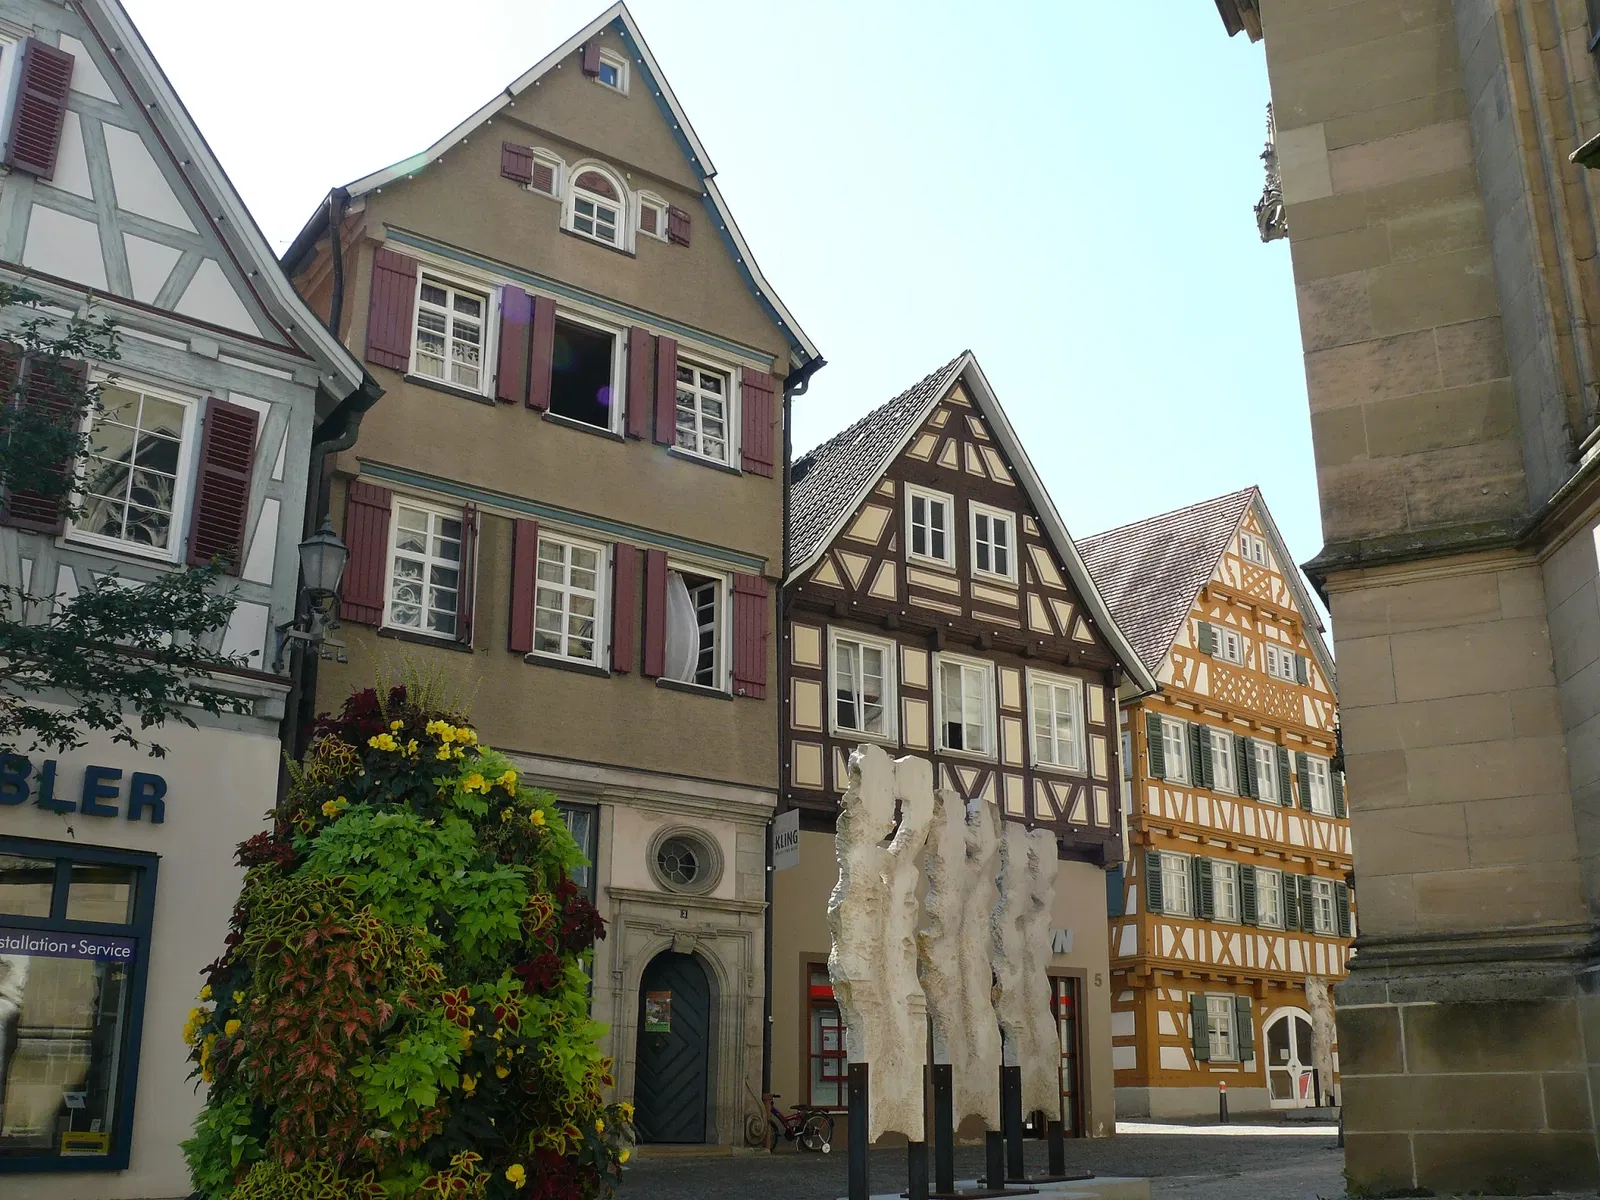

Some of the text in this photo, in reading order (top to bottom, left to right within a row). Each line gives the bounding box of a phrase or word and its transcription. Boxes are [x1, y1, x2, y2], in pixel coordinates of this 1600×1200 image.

[0, 753, 168, 824] BLER
[775, 829, 798, 850] KLING
[79, 940, 131, 958] Service
[1094, 973, 1102, 987] 5
